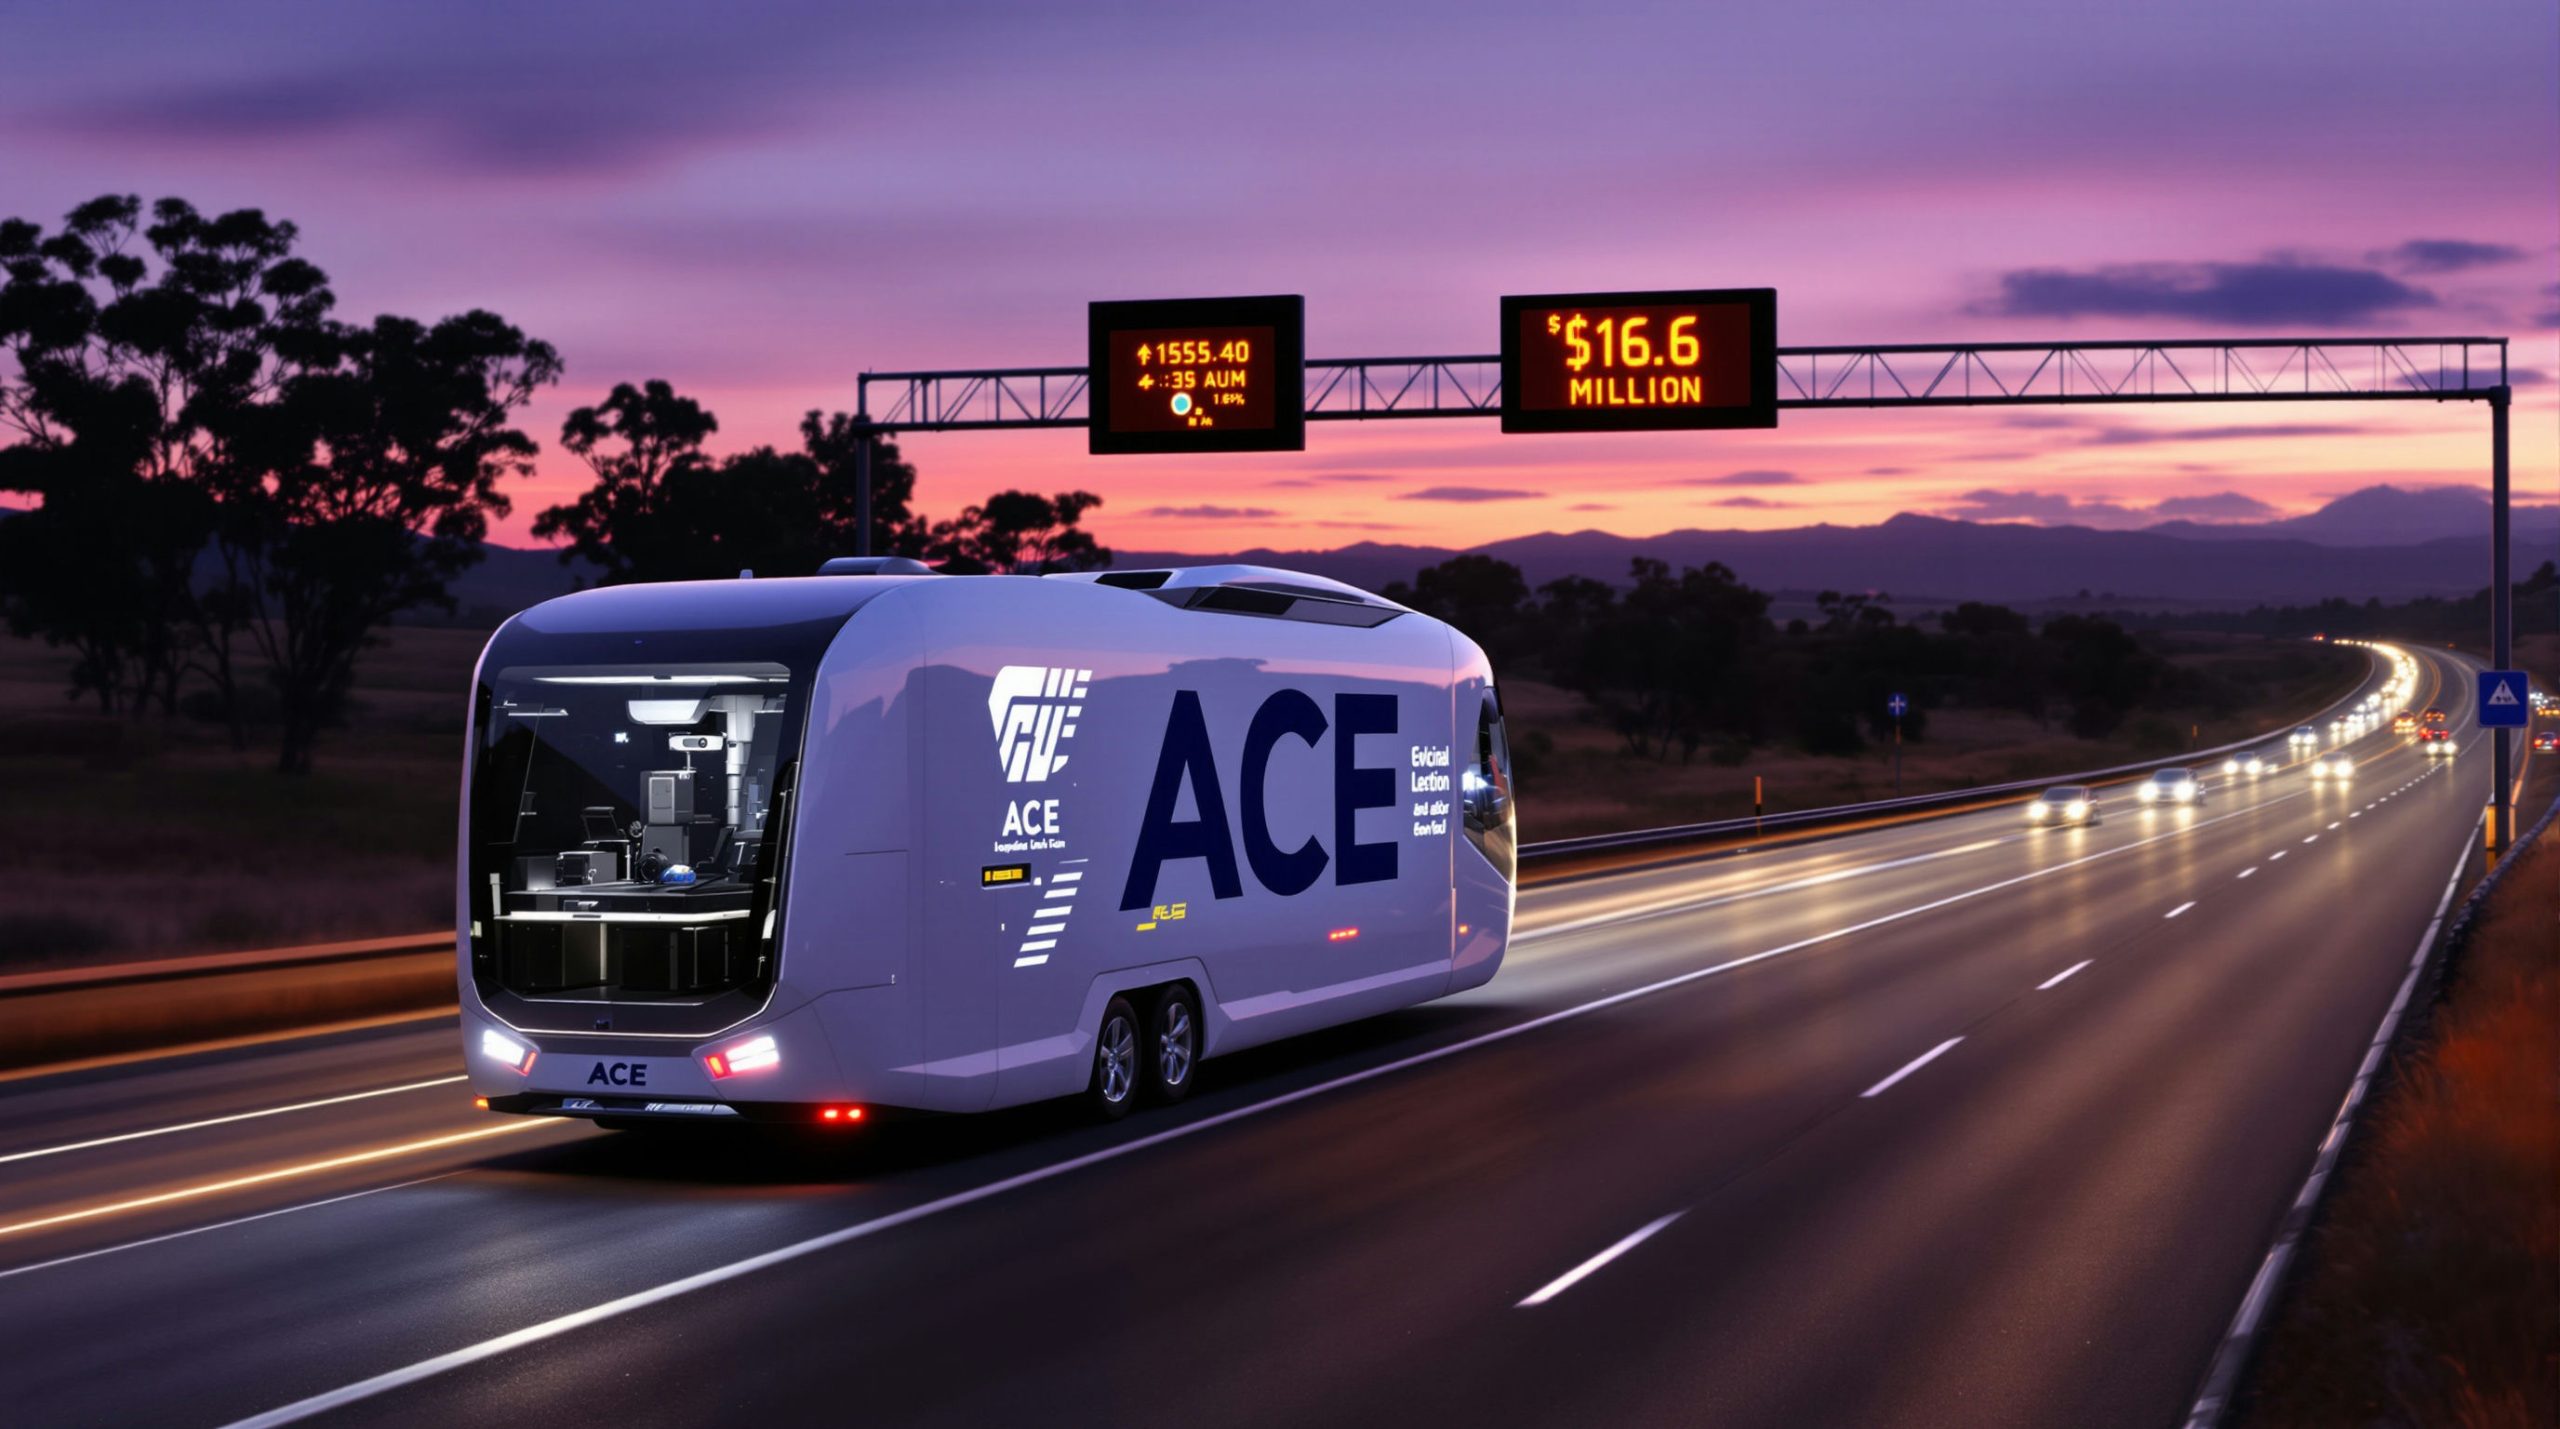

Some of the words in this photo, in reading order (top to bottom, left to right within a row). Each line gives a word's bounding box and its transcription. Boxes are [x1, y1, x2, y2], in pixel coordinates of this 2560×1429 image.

[1156, 340, 1249, 364] 1555.40
[1565, 313, 1700, 371] $16.6
[1204, 370, 1246, 388] AUM
[1570, 376, 1701, 405] MILLION
[1119, 688, 1399, 911] ACE
[1002, 799, 1060, 837] ACE
[587, 1062, 648, 1087] ACE
